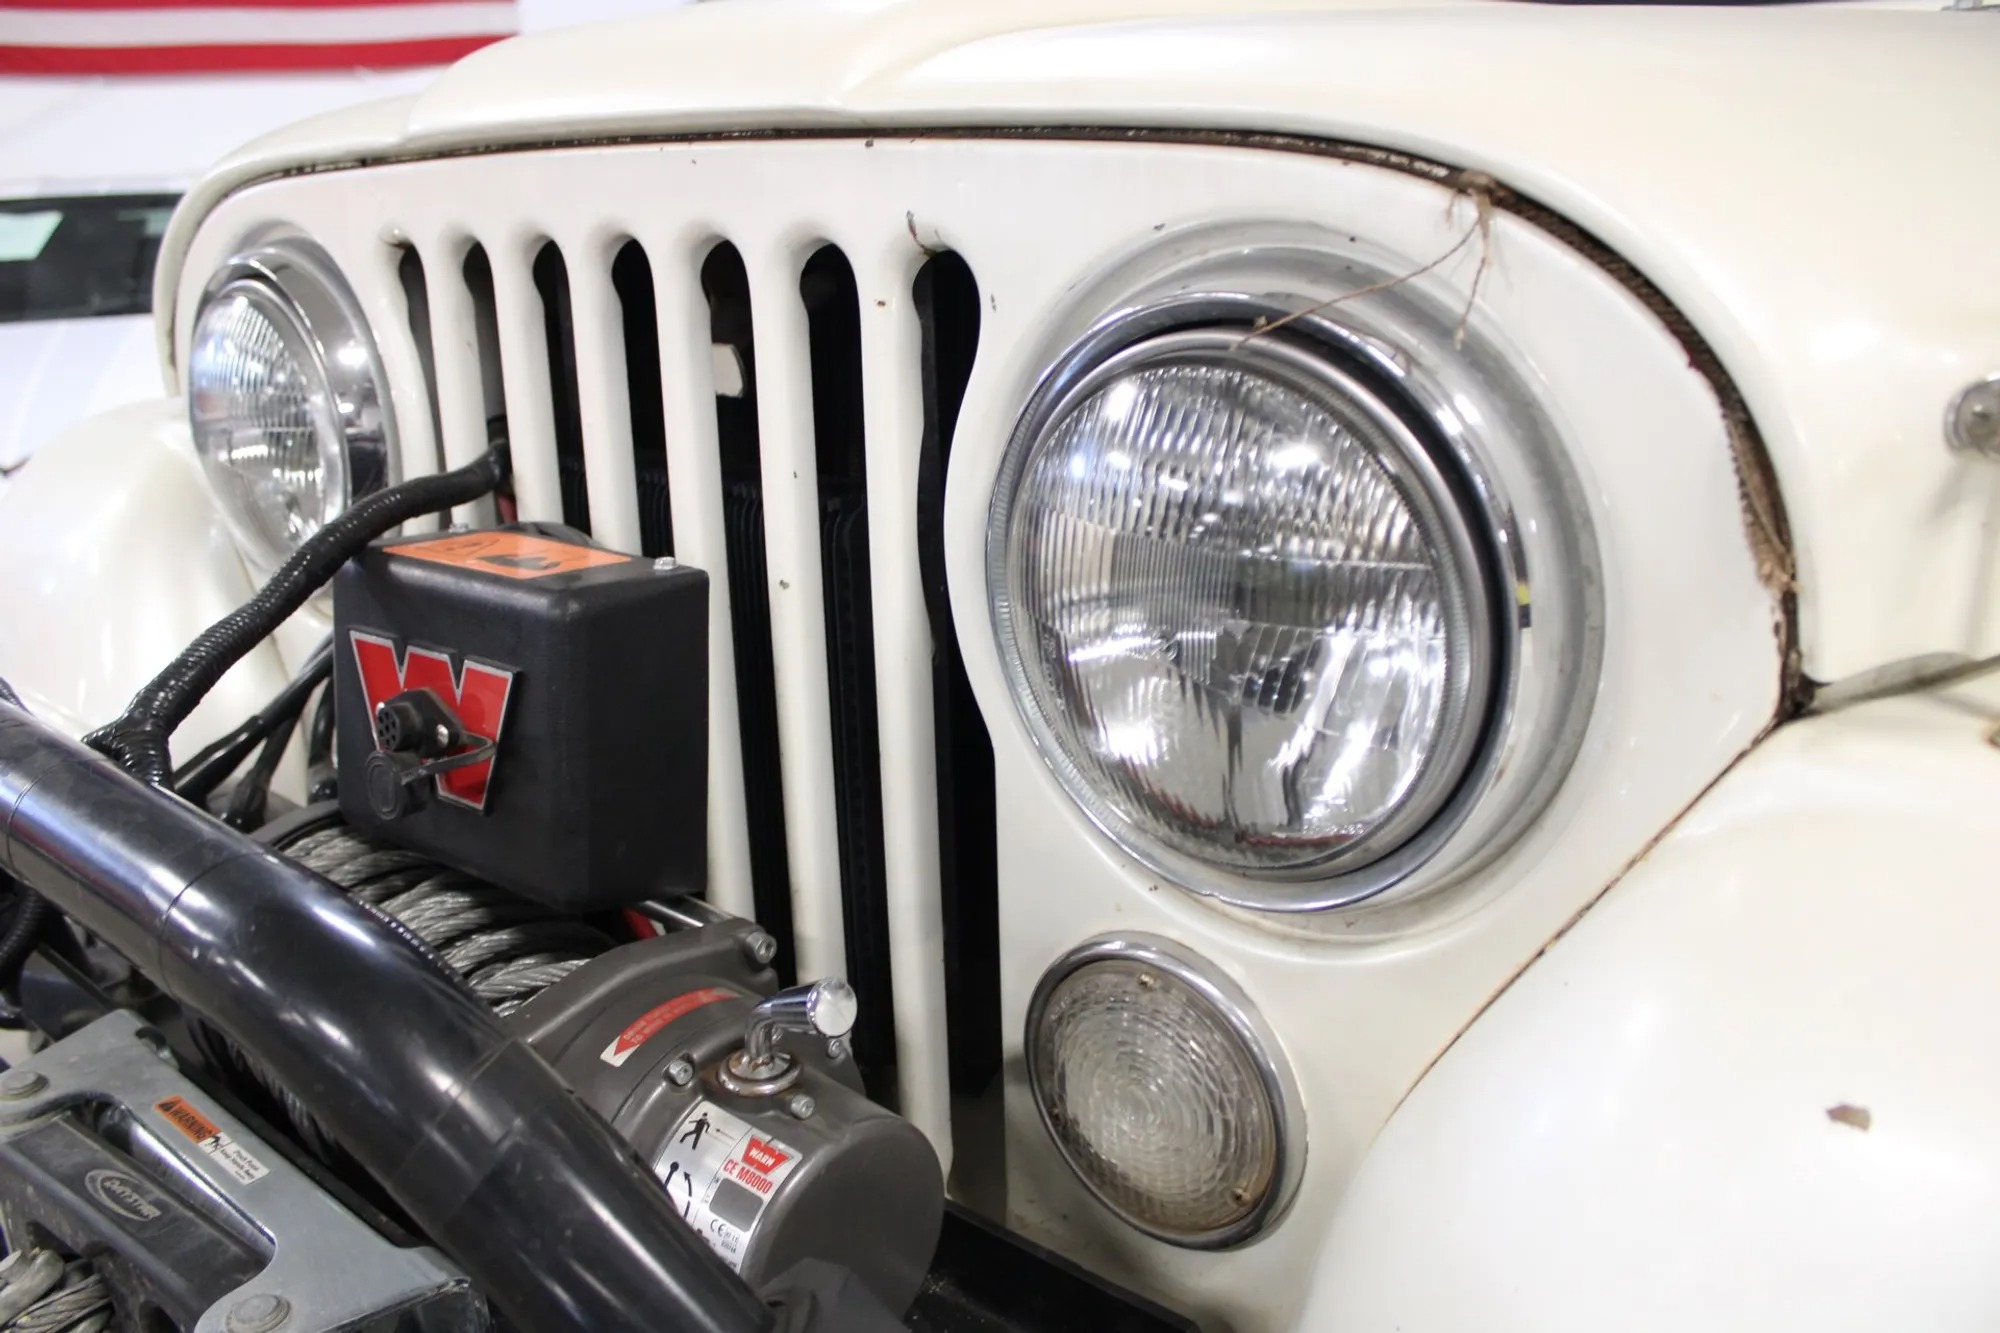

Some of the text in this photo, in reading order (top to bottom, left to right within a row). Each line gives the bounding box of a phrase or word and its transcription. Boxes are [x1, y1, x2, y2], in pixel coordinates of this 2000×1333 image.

[169, 1107, 213, 1140] WARNING
[749, 1147, 777, 1168] WARN
[723, 1158, 774, 1195] CE M8000
